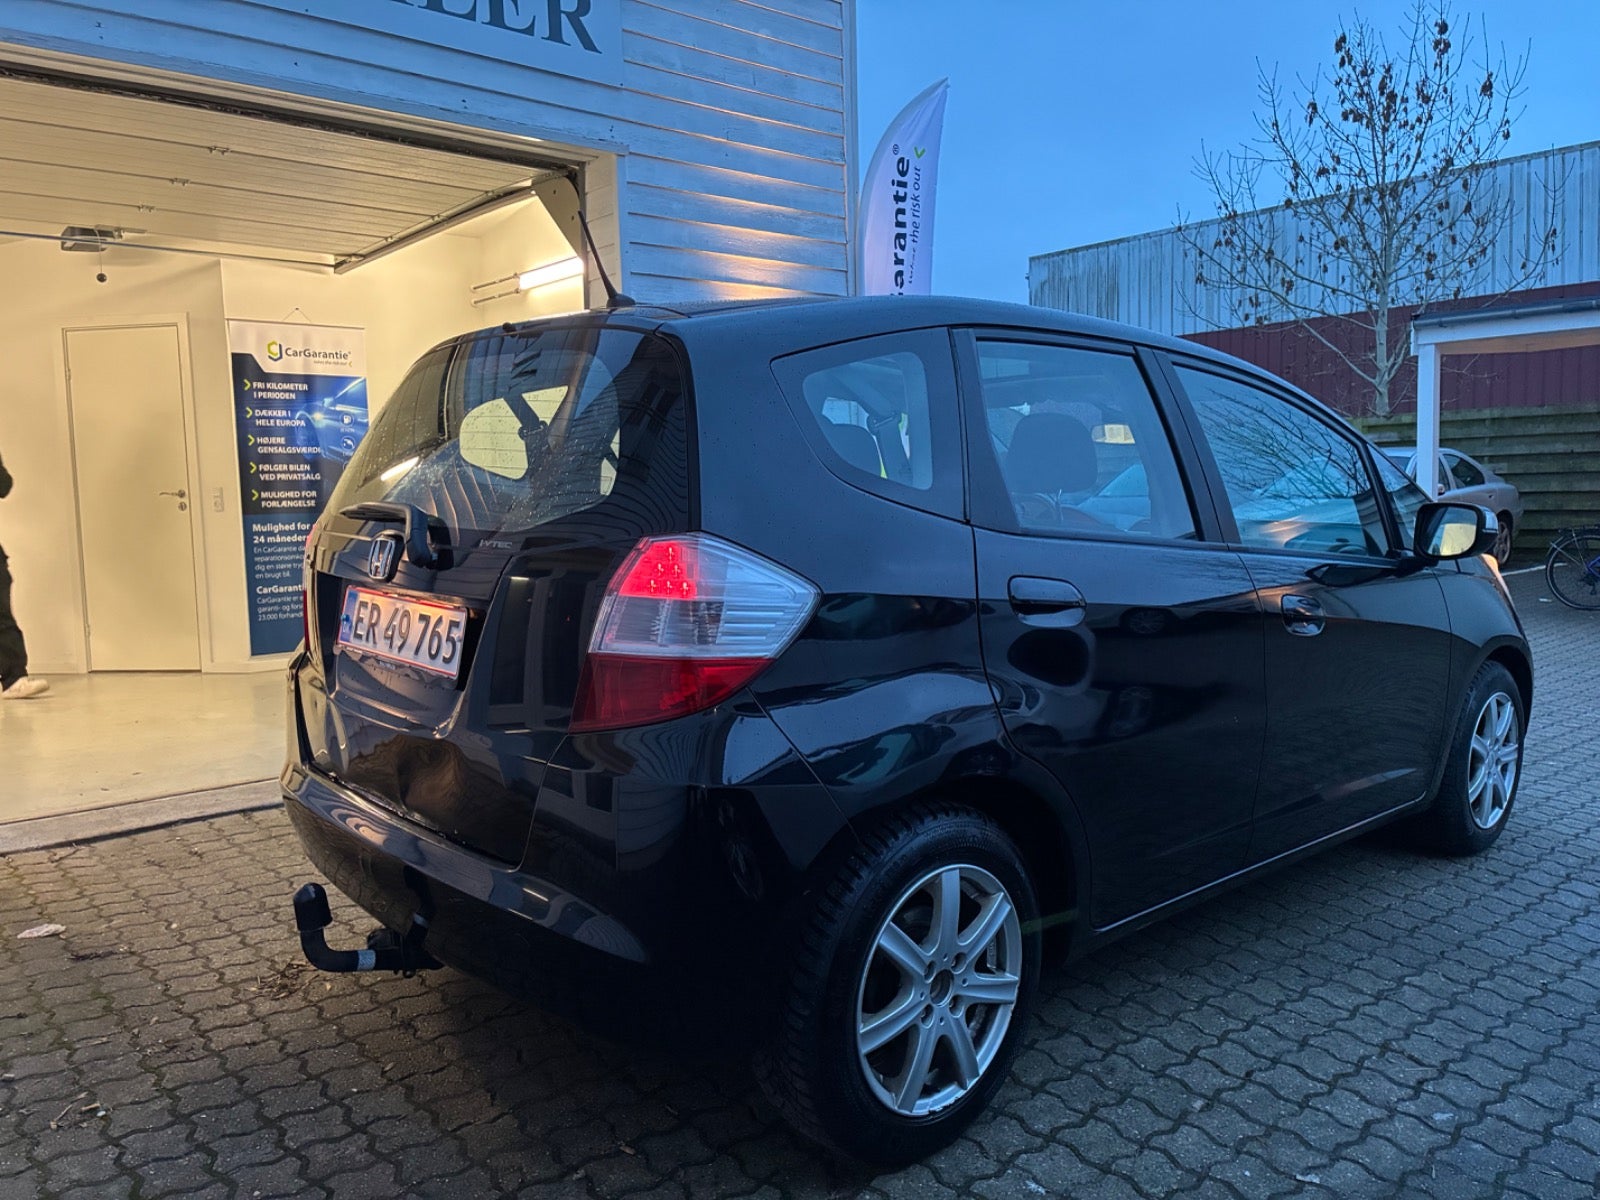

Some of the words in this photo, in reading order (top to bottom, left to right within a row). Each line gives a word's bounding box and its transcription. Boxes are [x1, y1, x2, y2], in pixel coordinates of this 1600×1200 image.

[913, 166, 921, 191] out
[911, 191, 921, 217] risk
[910, 219, 921, 244] the
[253, 382, 266, 391] FRI
[266, 382, 308, 391] KILOMETER
[258, 392, 296, 400] PERIODEN
[255, 409, 287, 418] DÆKKER
[256, 419, 275, 427] HELE
[276, 419, 306, 427] EUROPA
[257, 436, 286, 445] HØJERE
[259, 464, 288, 472] FØLGER
[289, 464, 311, 472] BILEN
[276, 473, 321, 481] PRIVATSALG
[260, 490, 300, 499] MULIGHED
[262, 500, 316, 508] FORLÆNGELSE
[252, 523, 296, 534] Mulighed
[297, 522, 310, 531] for
[253, 536, 265, 544] 24
[352, 600, 381, 647] ER
[384, 607, 411, 654] 49
[413, 613, 461, 665] 765
